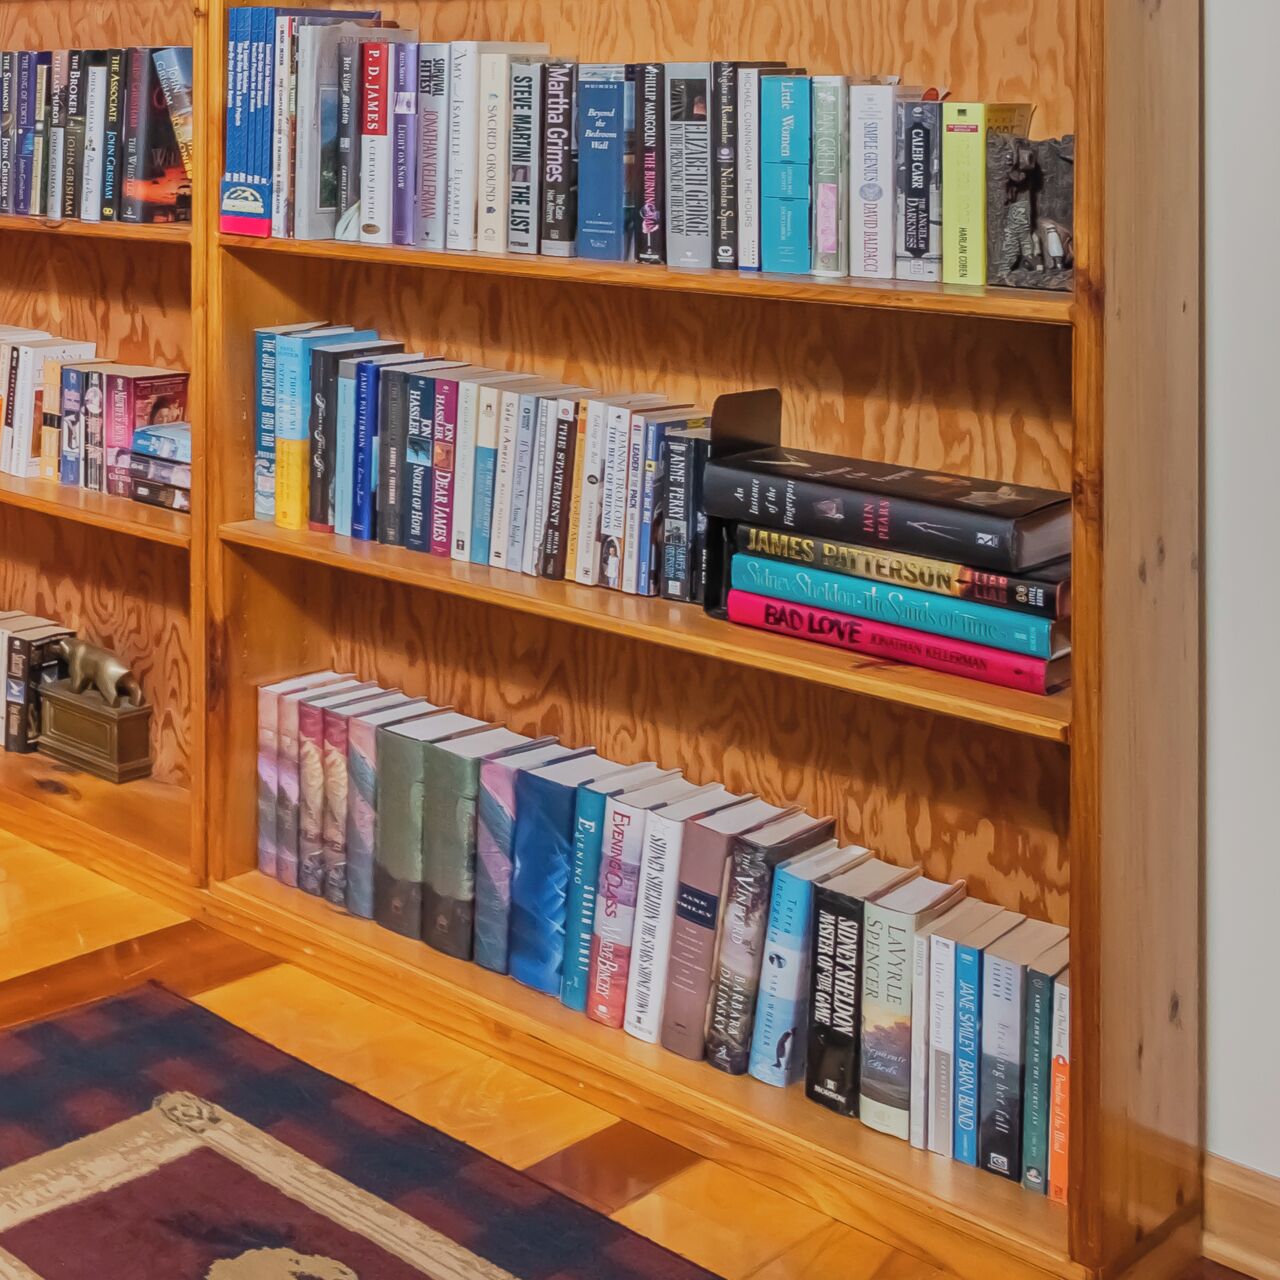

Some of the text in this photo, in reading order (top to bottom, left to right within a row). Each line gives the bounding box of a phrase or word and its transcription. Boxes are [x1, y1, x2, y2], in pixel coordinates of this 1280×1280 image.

[68, 71, 80, 114] BROKER
[156, 61, 173, 106] GRISHAM
[166, 66, 182, 93] JOHN
[366, 50, 380, 130] P. D. JAMES
[420, 60, 431, 95] FITTEST
[431, 58, 444, 97] SURVIVAL
[645, 69, 656, 146] PHILLIP MARGOLIN
[781, 82, 794, 109] Little
[67, 135, 75, 167] JOHN
[105, 55, 120, 199] THE ASSOCIATE JOHN GRISHAM
[486, 105, 498, 203] SACRED GROUND
[510, 76, 532, 234] STEVE MARTINI THE LIST
[547, 68, 571, 182] Martha Grimes
[743, 73, 752, 228] MICHAEL CUNNINGHAM THE HOURS
[781, 115, 794, 156] Women
[422, 108, 437, 219] JONATHAN KELLERMAN
[684, 124, 709, 237] ELIZABETH GEORGE
[911, 129, 923, 189] CALEB CARR
[65, 170, 74, 215] GRISHAM
[718, 168, 733, 240] Nicholas Sparks
[863, 122, 878, 272] SIMPLE GENIUS DAVID BALDACCI
[906, 198, 917, 248] DARKNESS
[958, 227, 967, 278] HARLAN COBEN
[114, 390, 128, 447] MIDWIFE'S ADVICE
[409, 390, 421, 435] HASSLER
[421, 419, 432, 438] JON
[435, 395, 445, 439] HASSLER
[444, 423, 454, 441] JON
[410, 465, 424, 535] NORTH OF HOPE
[550, 423, 568, 525] THE STATEMENT
[613, 431, 627, 530] JOANNA TROLLOPE
[669, 454, 686, 520] ANNE PERRY
[433, 471, 450, 543] DEAR JAMES
[863, 502, 875, 533] IAIN
[877, 500, 890, 540] PEARS
[747, 528, 953, 590] JAMES PATTERSON
[764, 603, 864, 643] BAD LOVE
[869, 632, 987, 669] JONATHAN KELLERMAN
[578, 884, 594, 972] SUSAN MINOT
[595, 811, 631, 999] EVENING CLASS MAEVE BINCHY
[783, 899, 798, 935] Terra
[833, 917, 859, 1037] SIDNEY SHELDON
[865, 916, 882, 999] SPENCER
[714, 967, 732, 1034] DELINSKY
[727, 975, 746, 1037] BARBARA
[958, 979, 975, 1130] JANE SMILEY BARN BLIND
